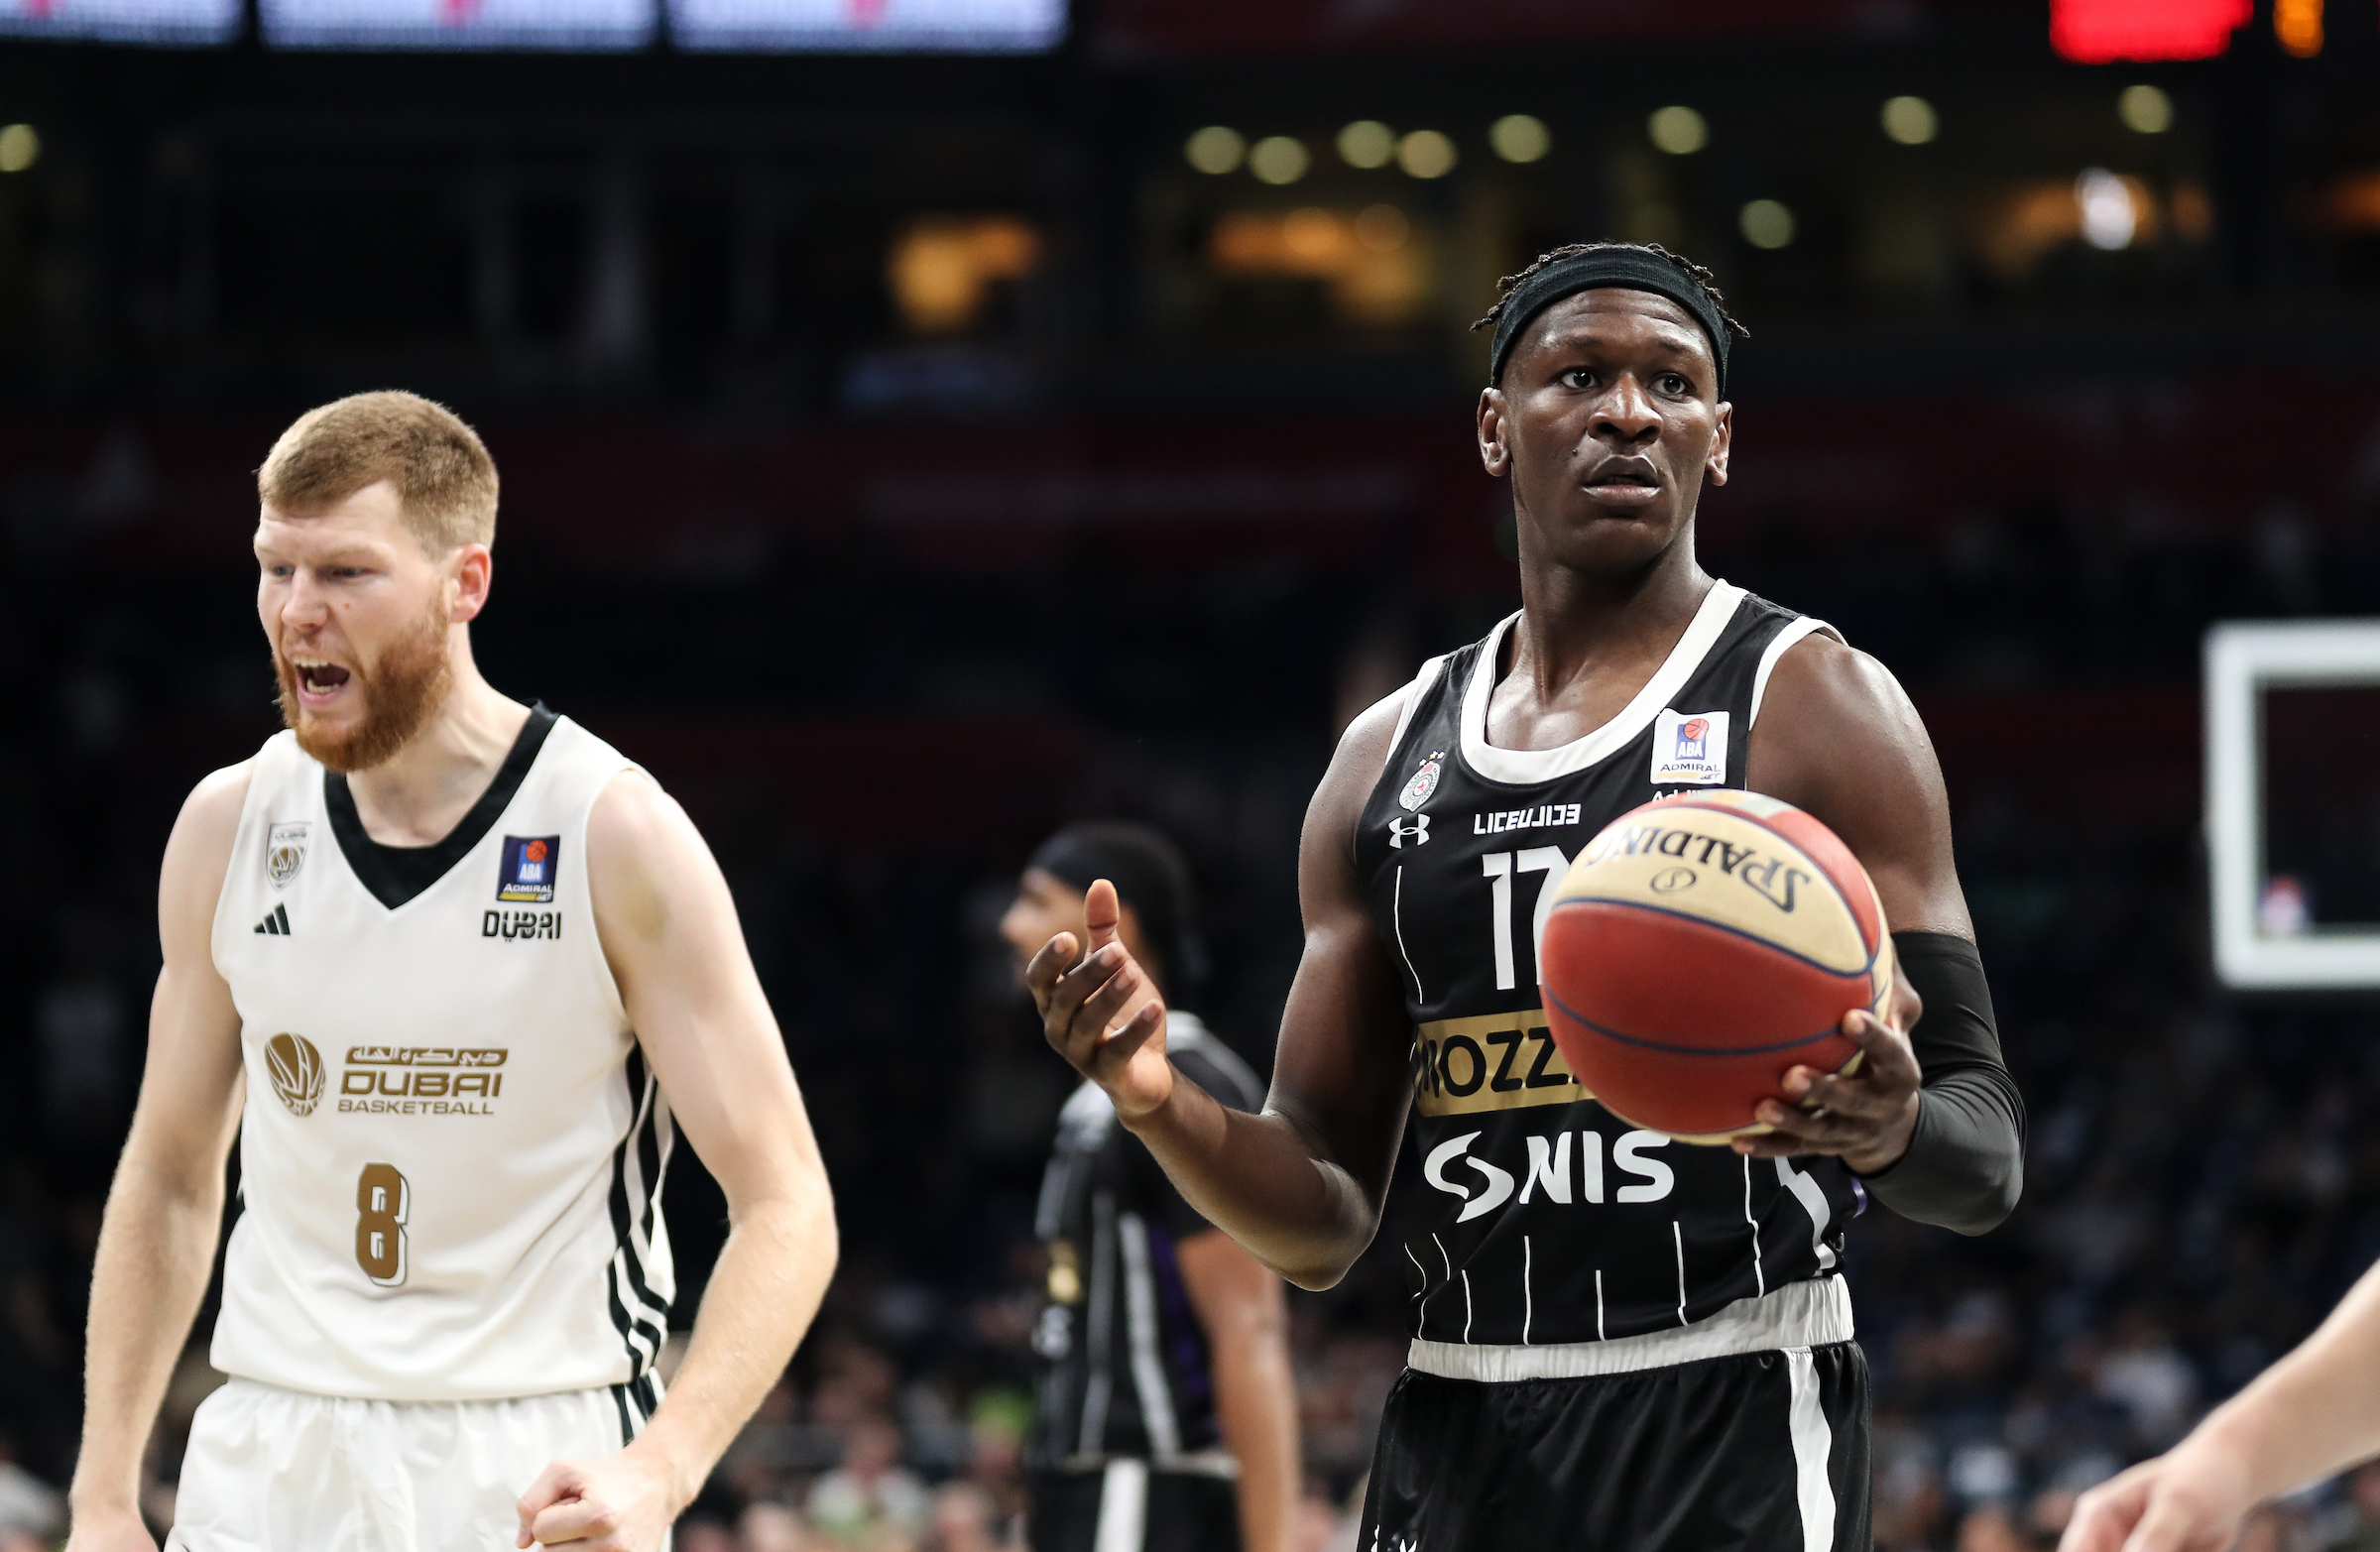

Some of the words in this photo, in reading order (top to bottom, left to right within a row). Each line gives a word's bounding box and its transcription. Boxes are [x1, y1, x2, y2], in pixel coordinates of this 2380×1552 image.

[1677, 741, 1704, 758] ABA
[1660, 764, 1722, 773] ADMIRAL
[519, 863, 543, 881] ABA
[503, 883, 552, 893] ADMIRAL
[482, 910, 561, 941] DUBAI
[1482, 845, 1571, 990] 17
[1416, 1025, 1580, 1098] MOZZ
[340, 1070, 503, 1097] DUBAI
[337, 1099, 494, 1115] BASKETBALL
[1518, 1130, 1675, 1204] NIS
[355, 1162, 410, 1287] 8
